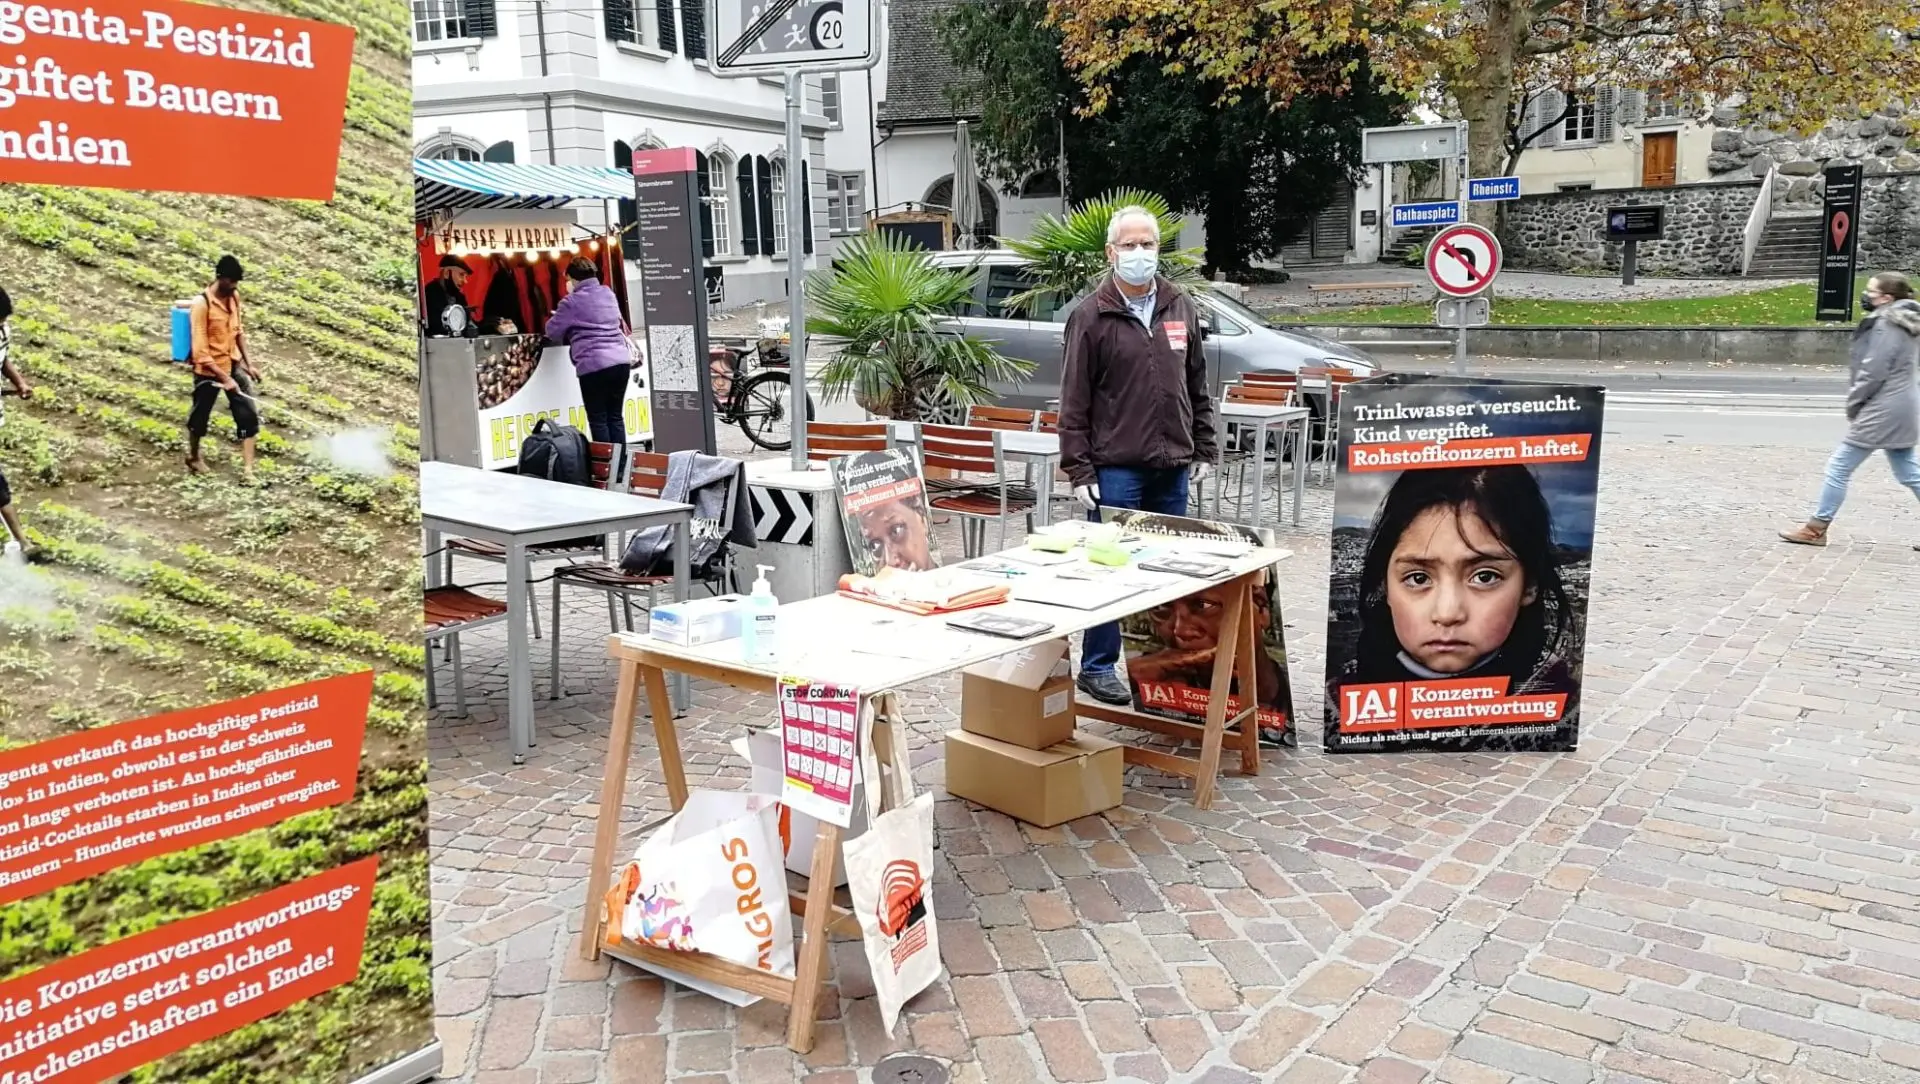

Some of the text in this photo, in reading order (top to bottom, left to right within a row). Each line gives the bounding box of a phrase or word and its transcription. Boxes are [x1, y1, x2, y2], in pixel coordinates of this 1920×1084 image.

[822, 20, 842, 40] 20
[123, 68, 283, 122] Bauern
[1472, 182, 1517, 197] Rheinstr.
[1395, 206, 1457, 222] Rathausplatz
[504, 227, 565, 249] MARRONI
[1354, 395, 1581, 421] Trinkwasser verseucht.
[490, 409, 561, 461] HEIS
[1353, 421, 1494, 445] Kind vergiftet.
[1353, 440, 1584, 467] Rohstoffkonzern haftet.
[785, 688, 851, 699] STOP CORONA
[1141, 683, 1176, 704] JA!
[1345, 687, 1398, 727] JA!
[1411, 686, 1501, 703] Konzern-
[1410, 700, 1557, 720] verantwortung
[0, 694, 319, 789] genta verkauft das hochgiftige Pestizid
[1340, 723, 1557, 744] Nichts als recht und gerecht. konzern-initiative.ch
[0, 722, 306, 811] o» in Indien, obwohl es in der Schweiz
[0, 737, 333, 837] on lange verboten ist. An hochgefährlichen
[0, 769, 296, 861] tizid-Cocktails starben in Indien über
[0, 858, 61, 887] Bauern
[75, 829, 156, 863] Hunderte
[158, 815, 222, 839] wurden
[224, 797, 277, 822] schwer
[277, 778, 341, 804] vergiftet.
[36, 883, 360, 1010] Konzernverantwortungs-
[123, 971, 191, 1012] setzt
[195, 937, 293, 986] solchen
[223, 980, 264, 1007] ein
[267, 946, 335, 992] Ende!
